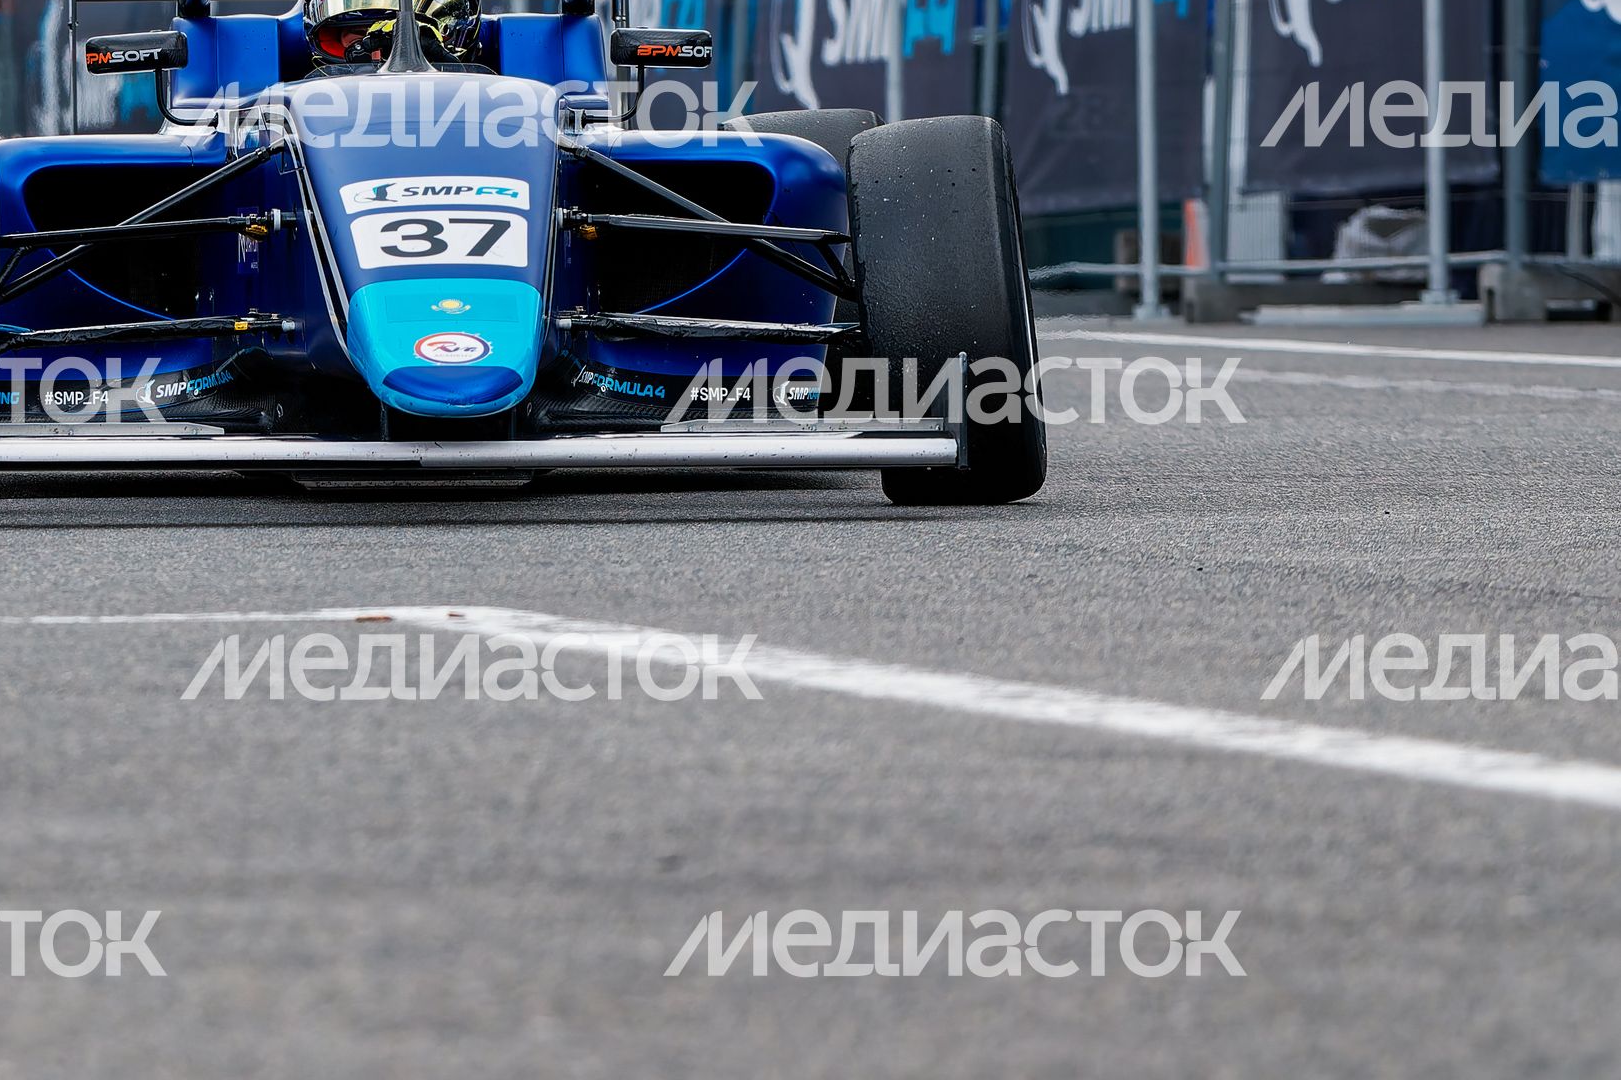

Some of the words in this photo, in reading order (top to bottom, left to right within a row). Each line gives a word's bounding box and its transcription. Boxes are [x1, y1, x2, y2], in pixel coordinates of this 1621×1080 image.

[380, 218, 512, 258] 37
[44, 391, 109, 406] #SMP_F4
[690, 387, 751, 401] #SMP_F4
